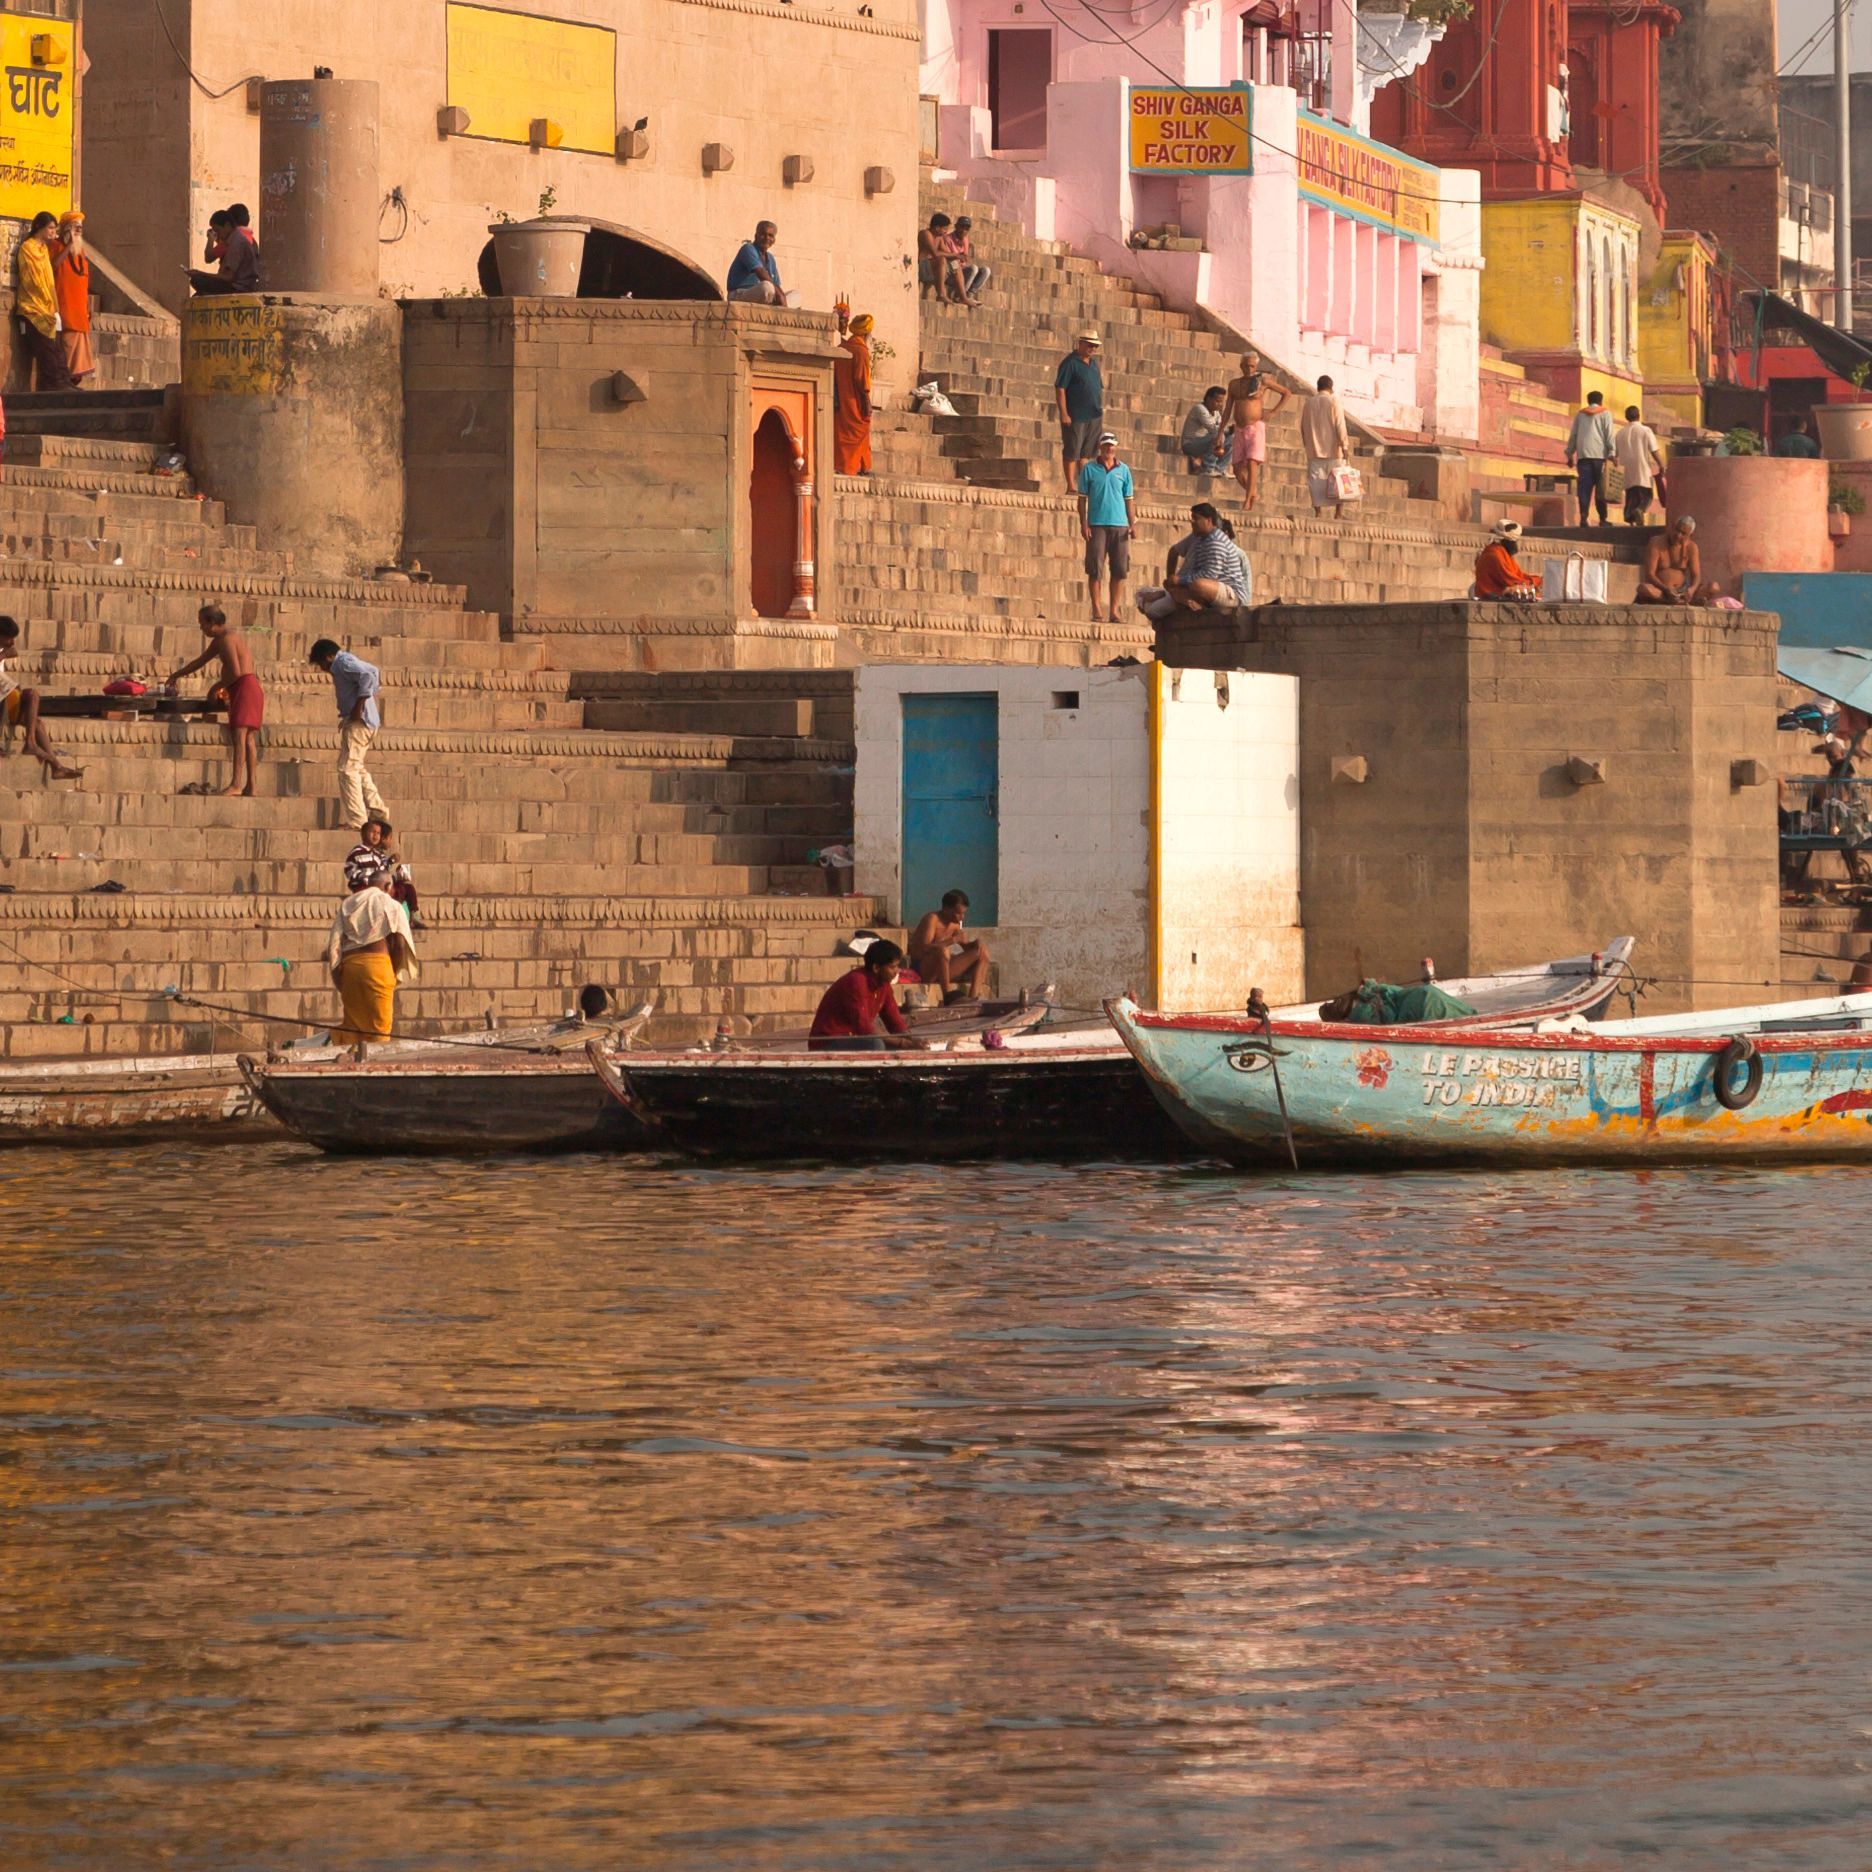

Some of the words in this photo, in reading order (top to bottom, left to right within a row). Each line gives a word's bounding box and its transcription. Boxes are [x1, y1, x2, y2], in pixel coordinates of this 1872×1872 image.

[5, 64, 63, 118] घाट
[1133, 95, 1176, 115] SHIV
[1180, 96, 1244, 116] GANGA
[1160, 120, 1209, 140] SILK
[1144, 143, 1236, 164] FACTORY
[1422, 1052, 1458, 1077] LE
[1423, 1079, 1462, 1106] TO
[1471, 1081, 1556, 1108] INDIA
